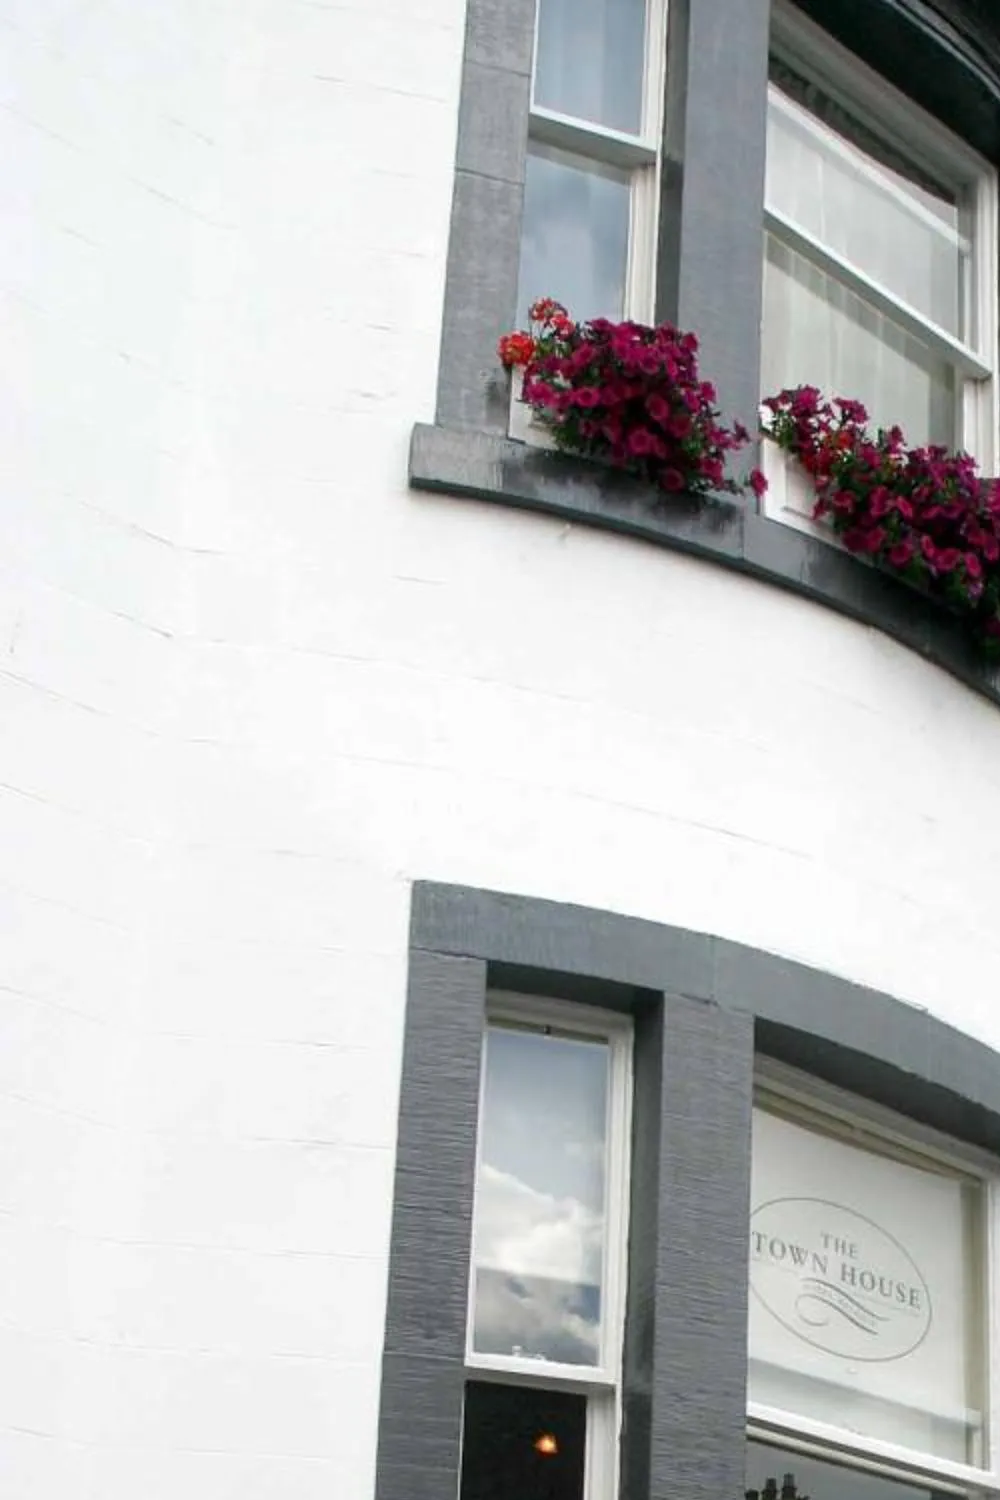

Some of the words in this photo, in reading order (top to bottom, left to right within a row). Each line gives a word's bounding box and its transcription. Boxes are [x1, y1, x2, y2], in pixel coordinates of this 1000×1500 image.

[751, 1231, 828, 1276] TOWN
[840, 1261, 921, 1311] HOUSE
[820, 1231, 859, 1260] THE
